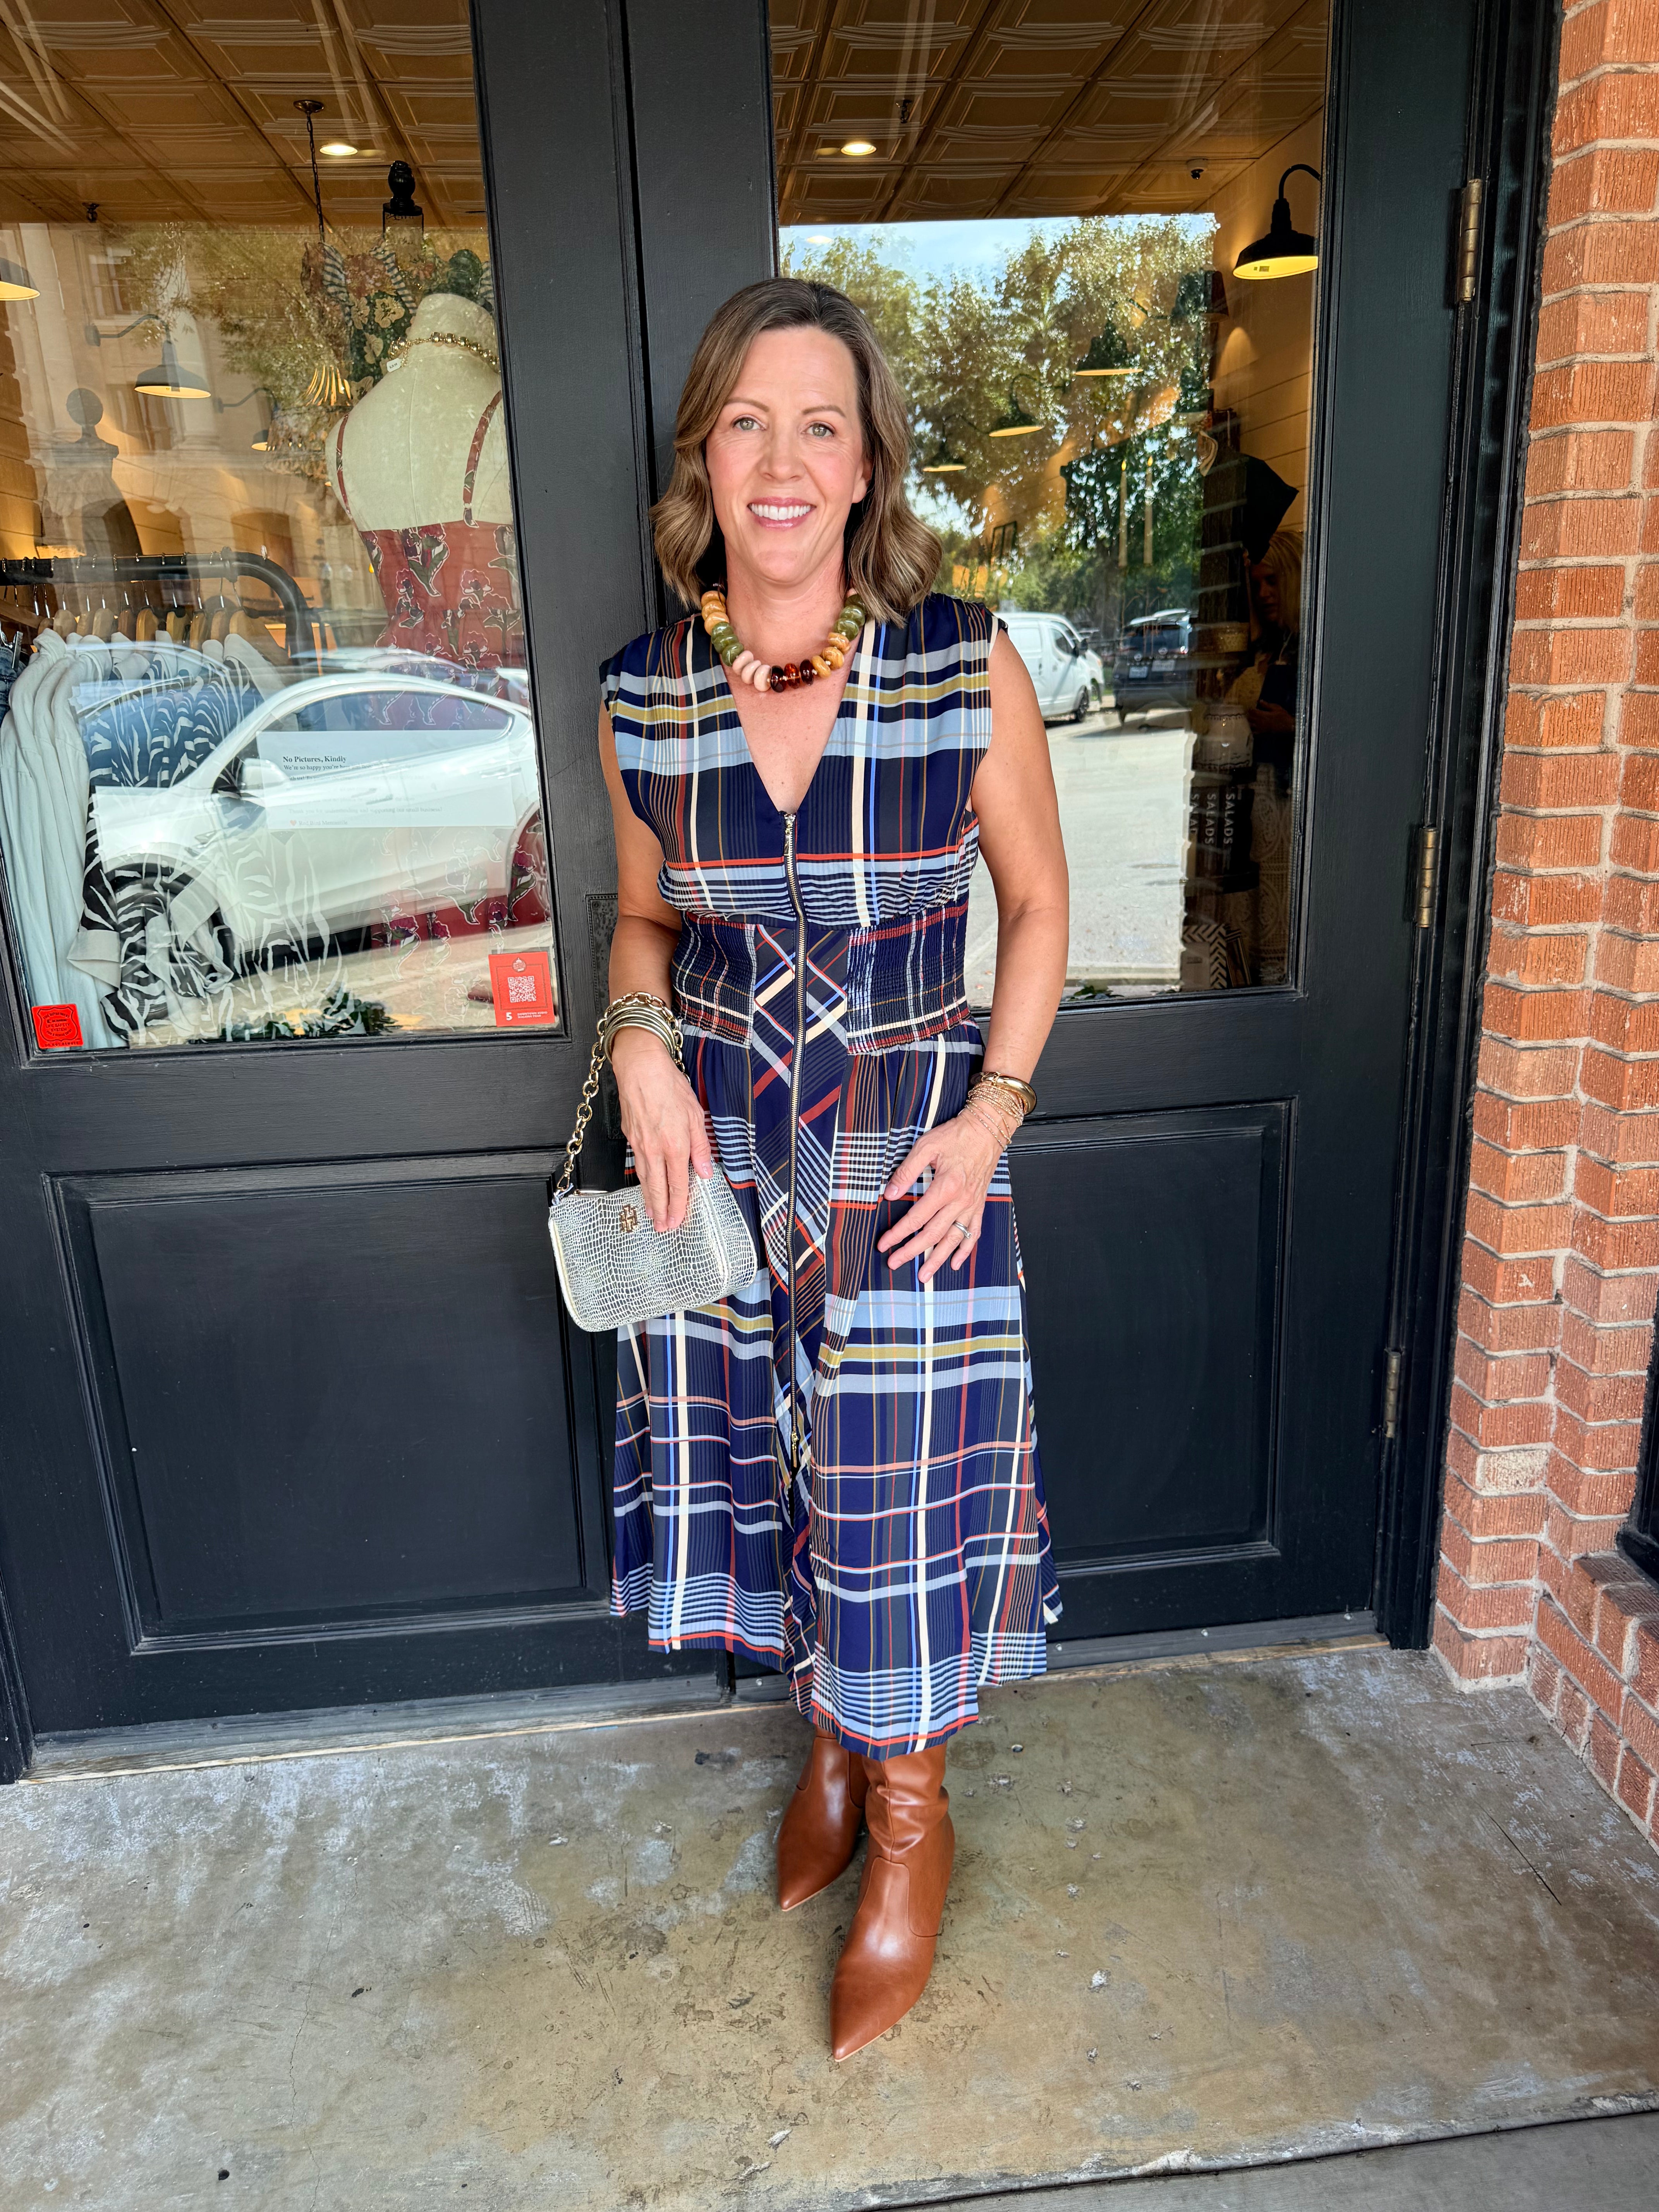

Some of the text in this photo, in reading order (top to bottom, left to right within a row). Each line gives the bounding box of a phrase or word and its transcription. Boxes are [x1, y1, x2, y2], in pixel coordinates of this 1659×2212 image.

[1204, 793, 1216, 844] SALADS
[1223, 793, 1235, 844] SALADS
[506, 1012, 513, 1021] 5
